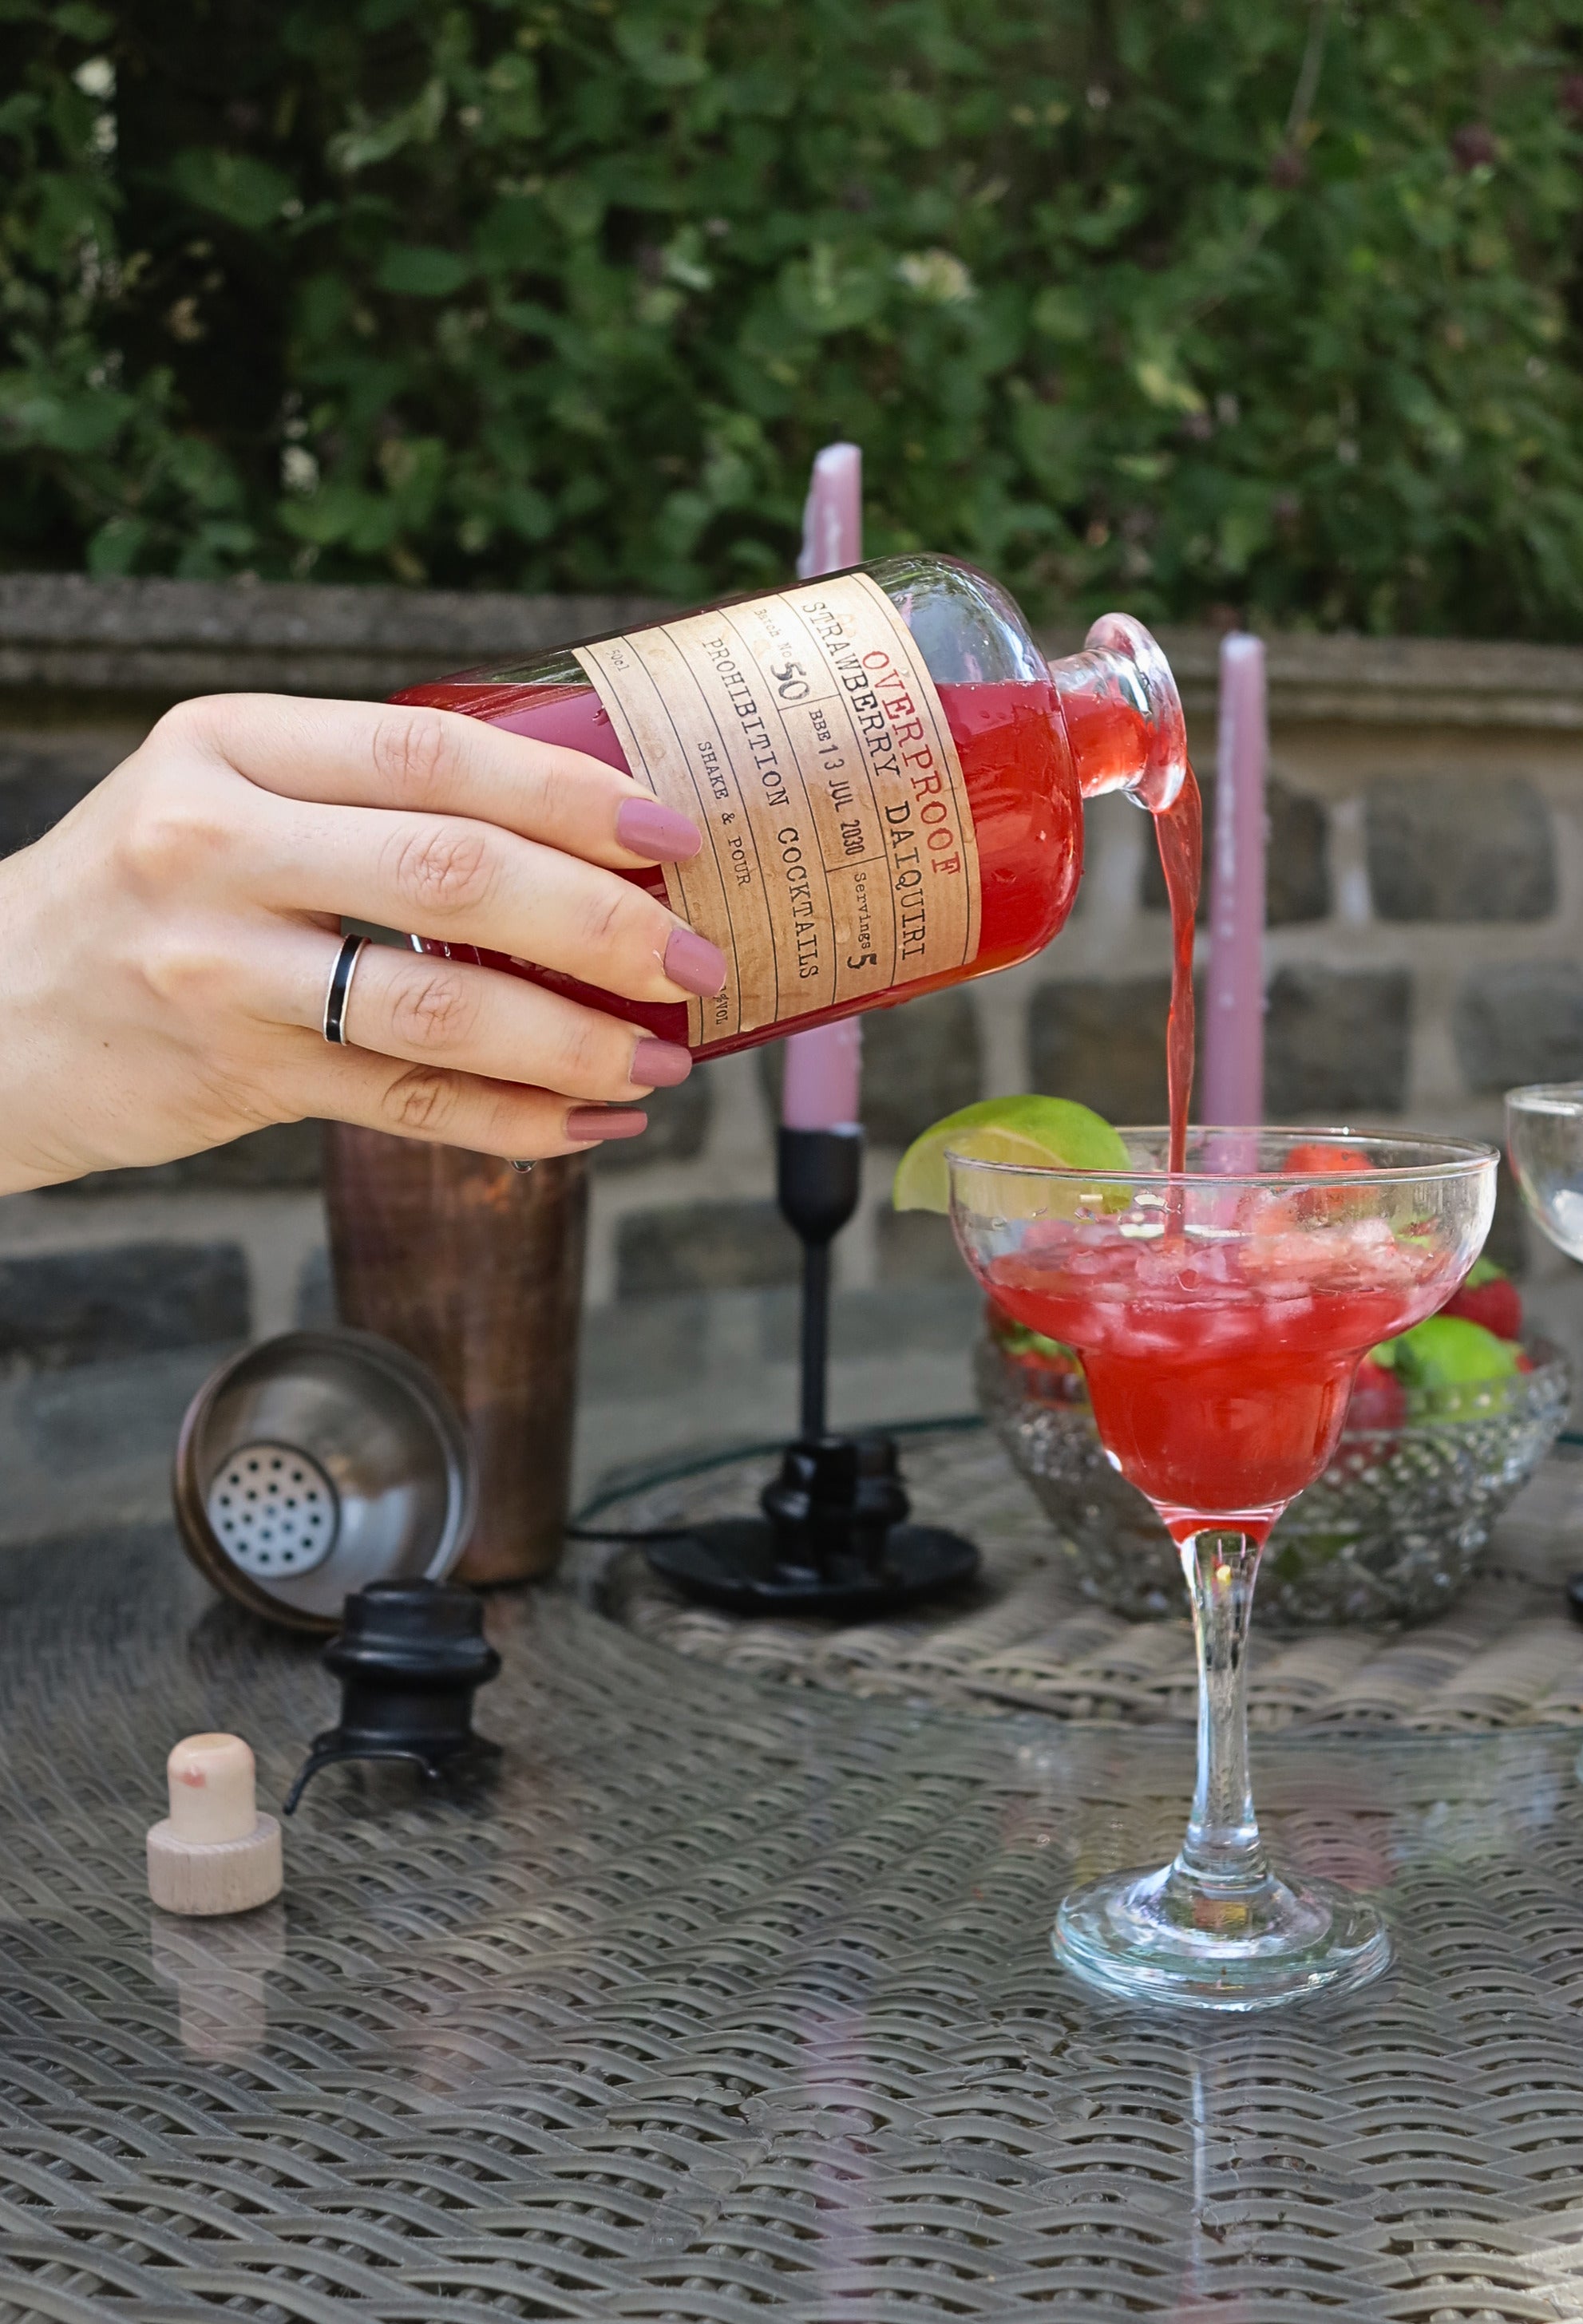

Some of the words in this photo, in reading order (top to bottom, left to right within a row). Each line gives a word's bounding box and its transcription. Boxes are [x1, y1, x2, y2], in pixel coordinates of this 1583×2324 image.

[754, 609, 780, 637] Batch
[778, 642, 792, 658] No
[770, 662, 810, 700] 50
[698, 741, 729, 800] SHAKE
[802, 602, 901, 777] STRAWBERRY
[885, 800, 925, 961] DAIQUIRI
[809, 709, 832, 741] BBE
[829, 780, 853, 812] JUL
[841, 820, 865, 856] 2030
[862, 650, 962, 875] OVERPROOF
[702, 637, 790, 806] PROHIBITION
[777, 827, 819, 978] COCKTAILS
[722, 812, 735, 825] &
[728, 836, 751, 886] POUR
[854, 872, 871, 949] Servings
[847, 953, 877, 970] 5
